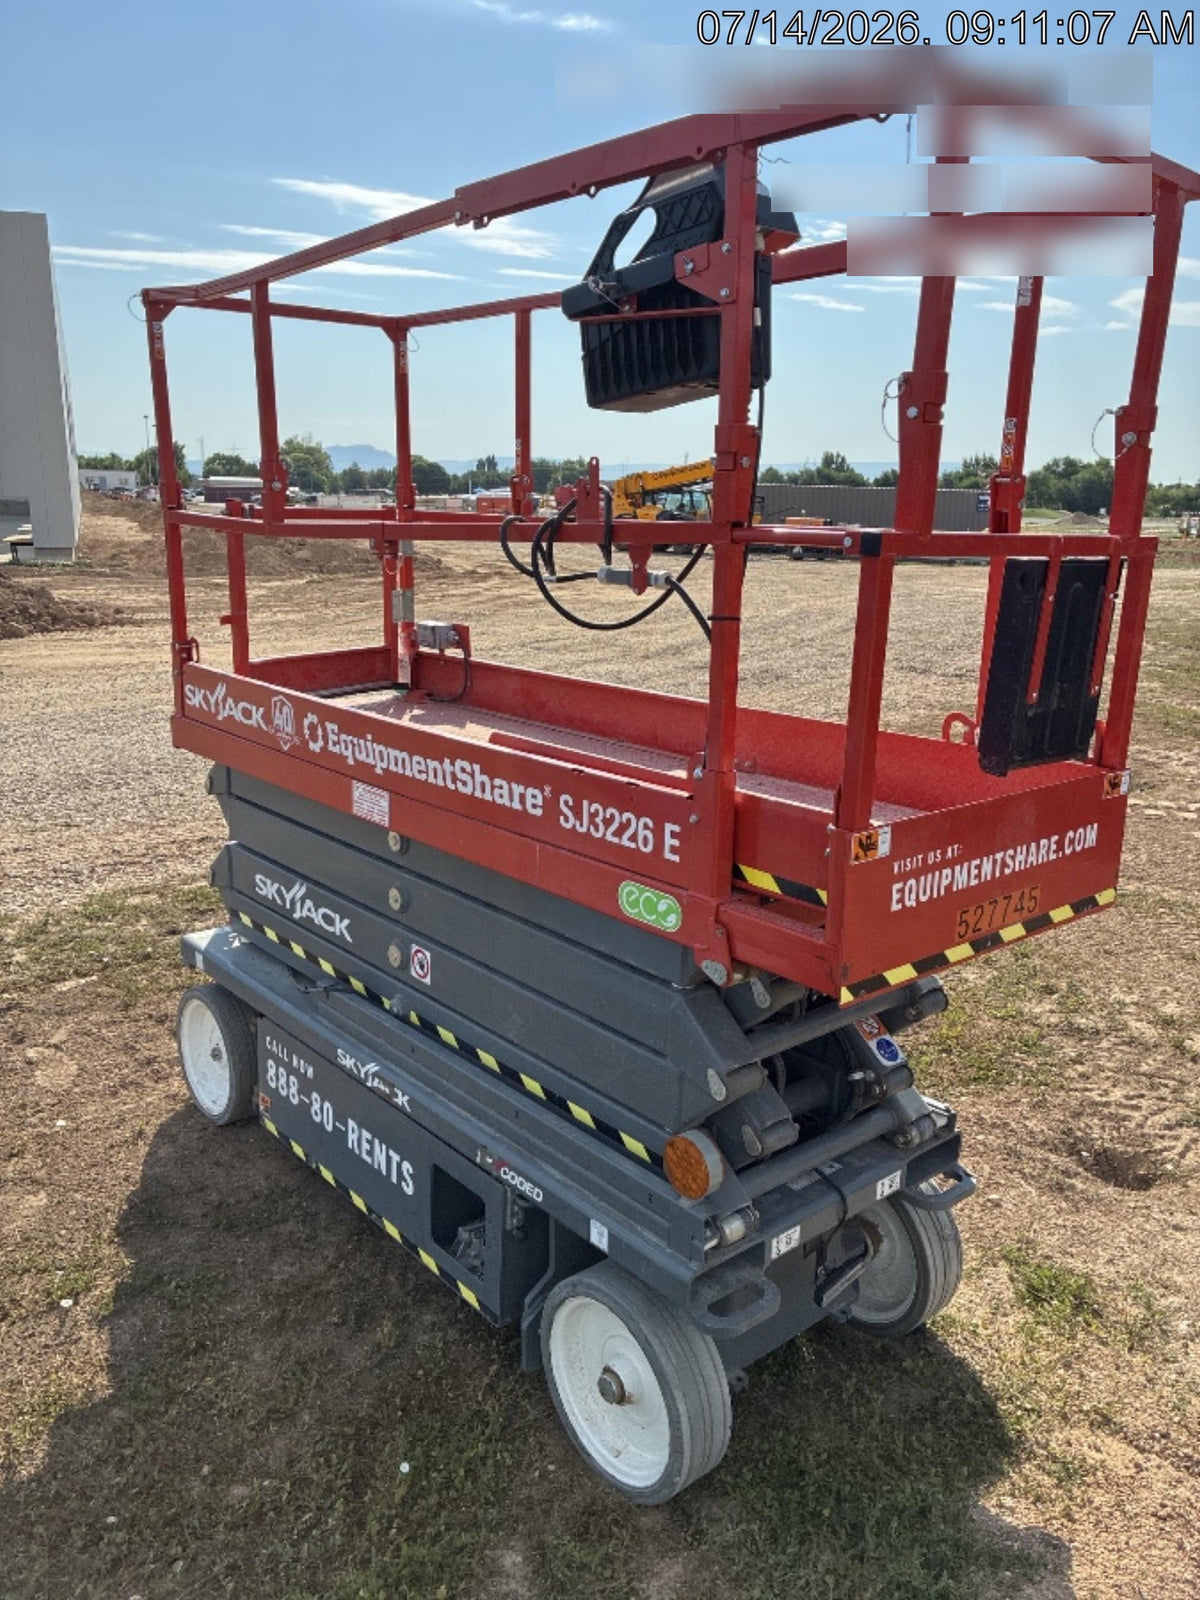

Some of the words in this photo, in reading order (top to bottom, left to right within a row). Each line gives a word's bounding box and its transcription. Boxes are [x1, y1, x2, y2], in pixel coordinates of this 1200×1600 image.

[184, 682, 268, 731] SKYJACK
[559, 793, 654, 853] SJ3226
[664, 822, 681, 863] E
[890, 823, 1098, 912] EQUIPMENTSHARE.COM
[893, 854, 924, 875] VISIT
[927, 849, 942, 865] US
[254, 873, 353, 942] SKYJACK
[957, 886, 1039, 939] 527745
[265, 1036, 289, 1062] CALL
[337, 1048, 411, 1112] SKYJK
[266, 1058, 415, 1196] 888-80-RENTS
